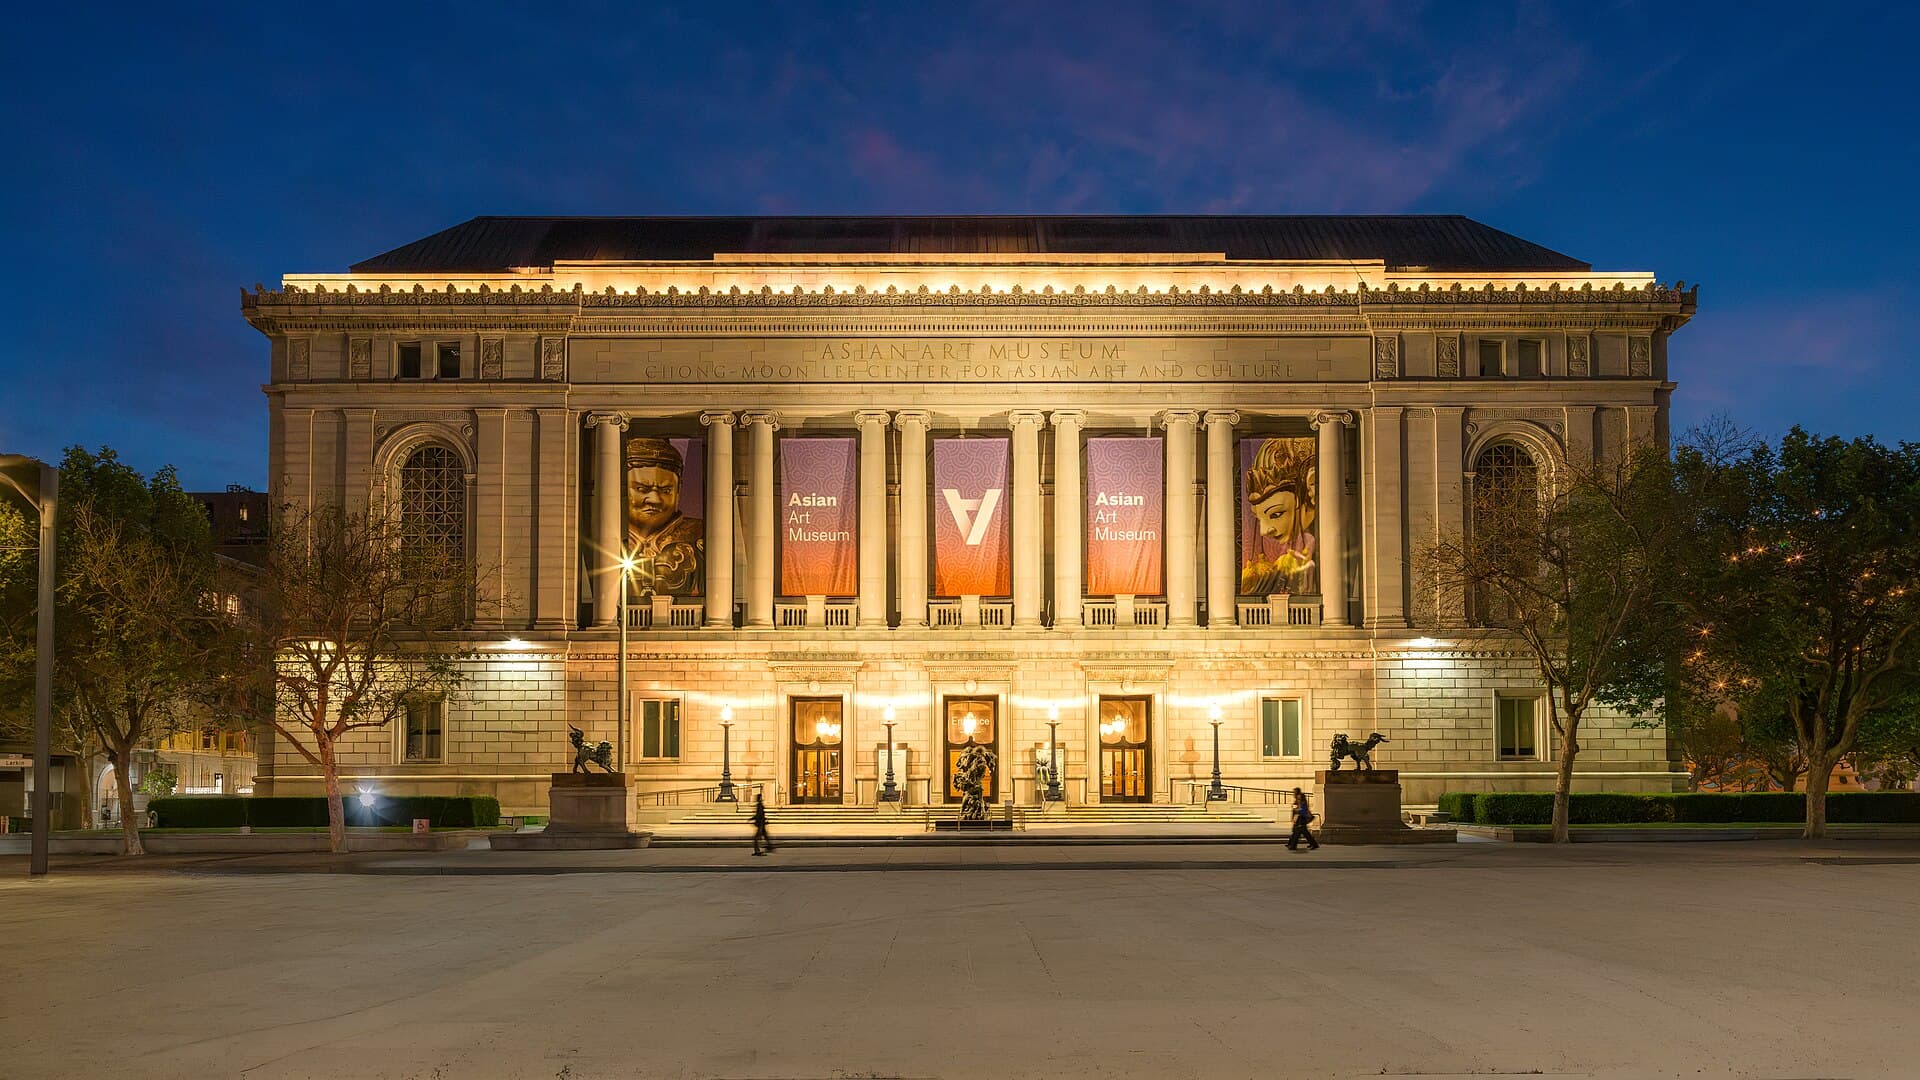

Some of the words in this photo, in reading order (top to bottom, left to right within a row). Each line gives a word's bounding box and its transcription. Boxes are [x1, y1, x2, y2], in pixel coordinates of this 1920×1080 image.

[821, 343, 906, 360] ASIAN
[922, 343, 973, 360] ART
[989, 343, 1120, 360] MUSEUM
[645, 365, 808, 379] CHONG-MOON
[823, 365, 855, 379] LEE
[867, 365, 950, 379] CENTER
[963, 365, 1001, 379] FOR
[1014, 365, 1078, 379] ASIAN
[1089, 365, 1129, 379] ART
[1140, 365, 1183, 379] AND
[1195, 365, 1294, 379] CULTURE
[788, 492, 837, 507] Asian
[1095, 491, 1144, 506] Asian
[788, 510, 810, 525] Art
[1095, 509, 1117, 524] Art
[789, 527, 850, 542] Museum
[1095, 527, 1156, 541] Museum
